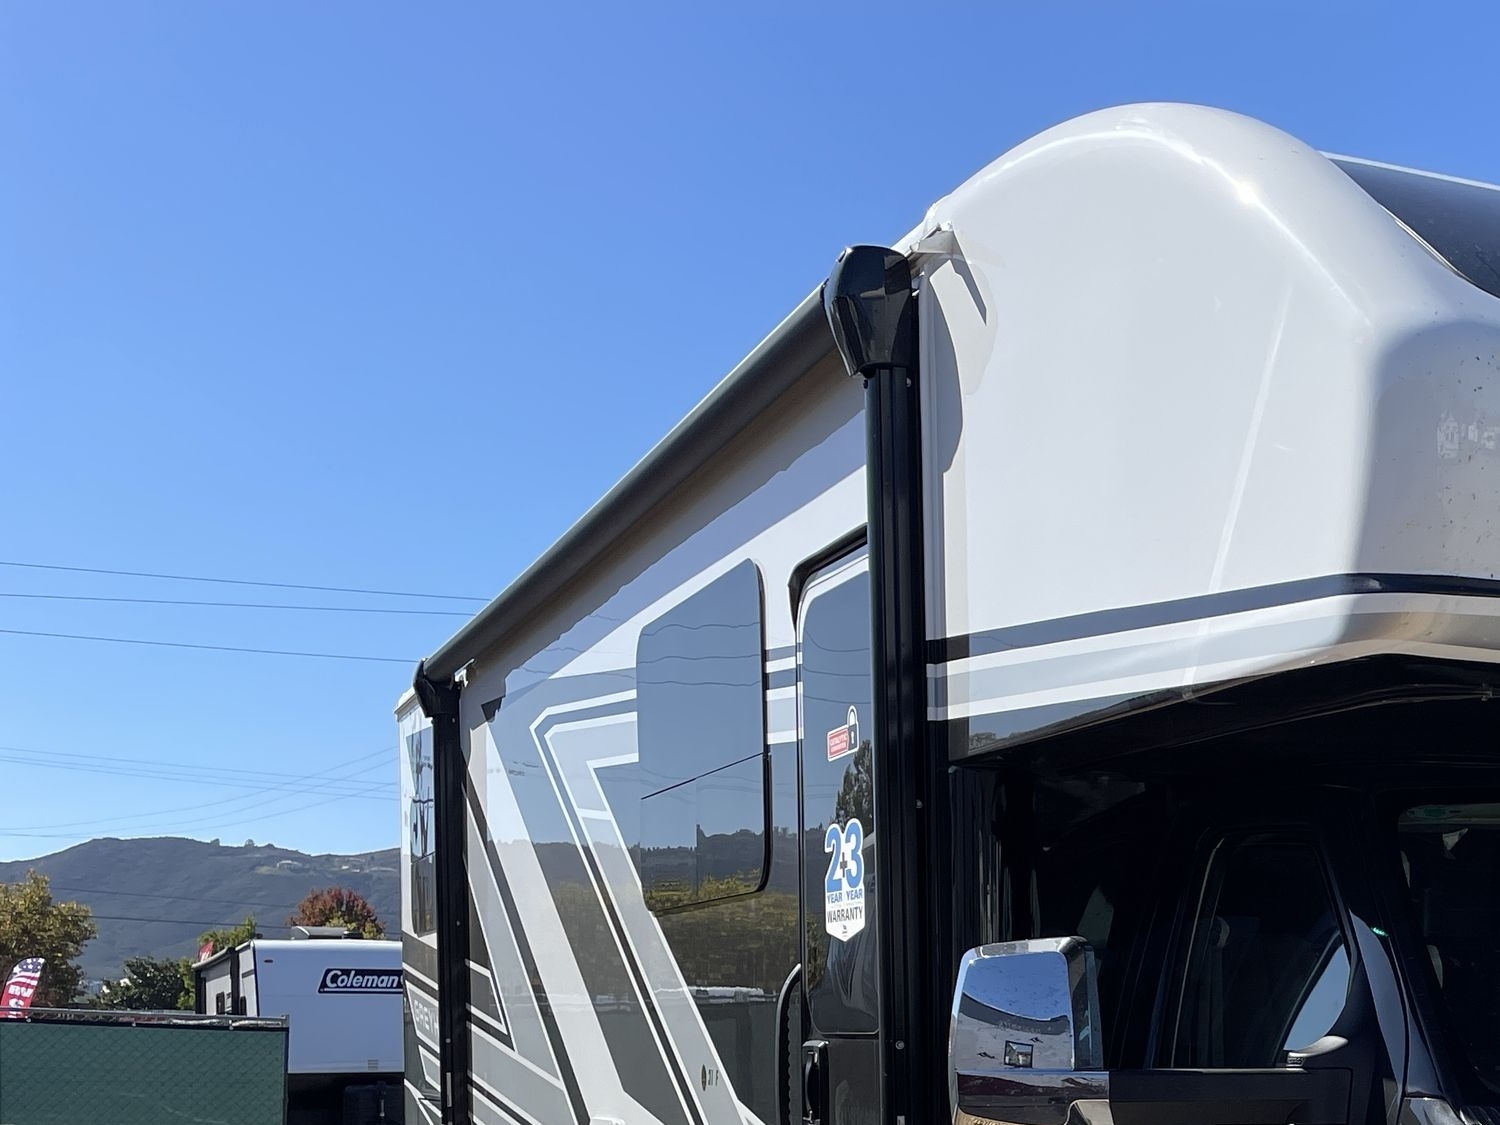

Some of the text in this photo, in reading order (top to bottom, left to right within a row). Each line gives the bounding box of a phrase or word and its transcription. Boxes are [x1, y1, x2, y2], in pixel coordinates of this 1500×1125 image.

[827, 888, 863, 904] YEAR YEAR
[827, 906, 863, 923] WARRANTY
[326, 970, 399, 988] Coleman
